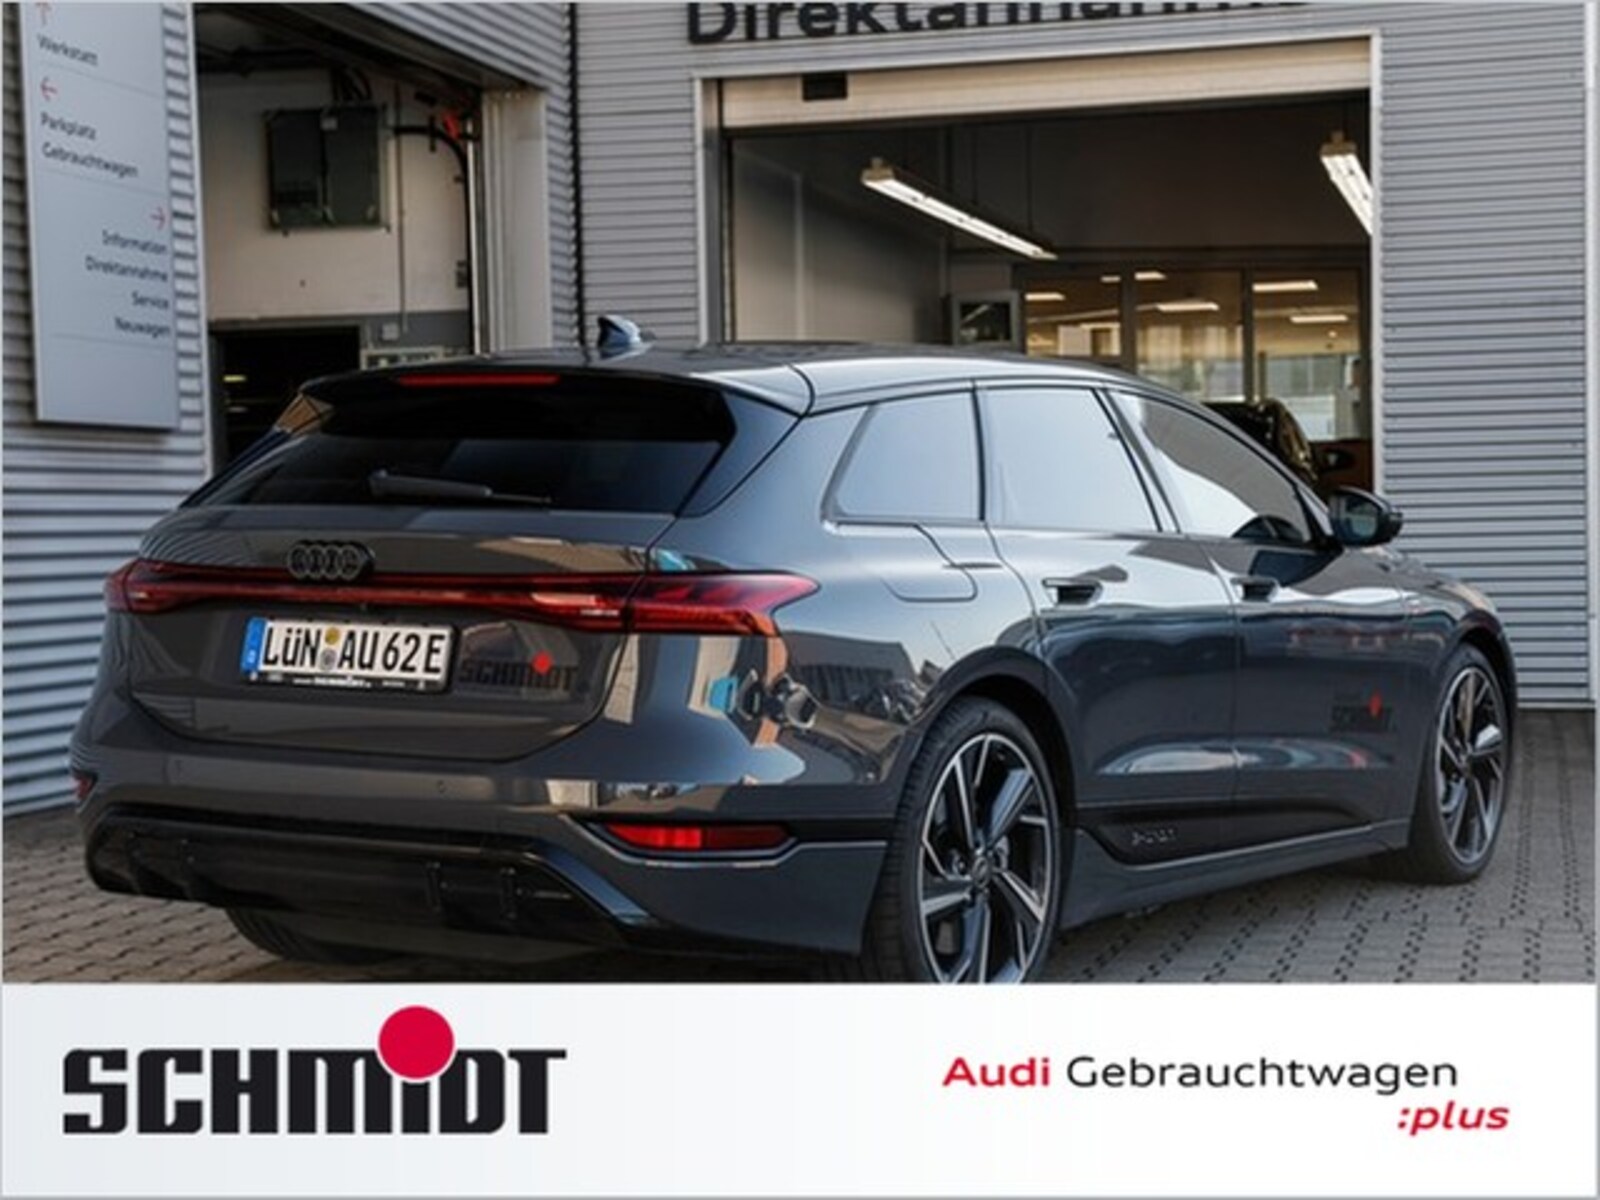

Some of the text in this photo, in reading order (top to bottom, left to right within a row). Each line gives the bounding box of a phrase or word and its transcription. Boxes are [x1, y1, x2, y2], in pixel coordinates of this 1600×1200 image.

[37, 33, 98, 67] Werkstatt
[40, 112, 97, 140] Parkplatz
[42, 142, 138, 178] Gebrauchtwagen
[102, 229, 167, 255] Information
[86, 255, 168, 282] Direktannahme
[132, 291, 169, 310] Service
[115, 316, 170, 339] Neuwagen
[459, 650, 579, 691] SCHMIDT
